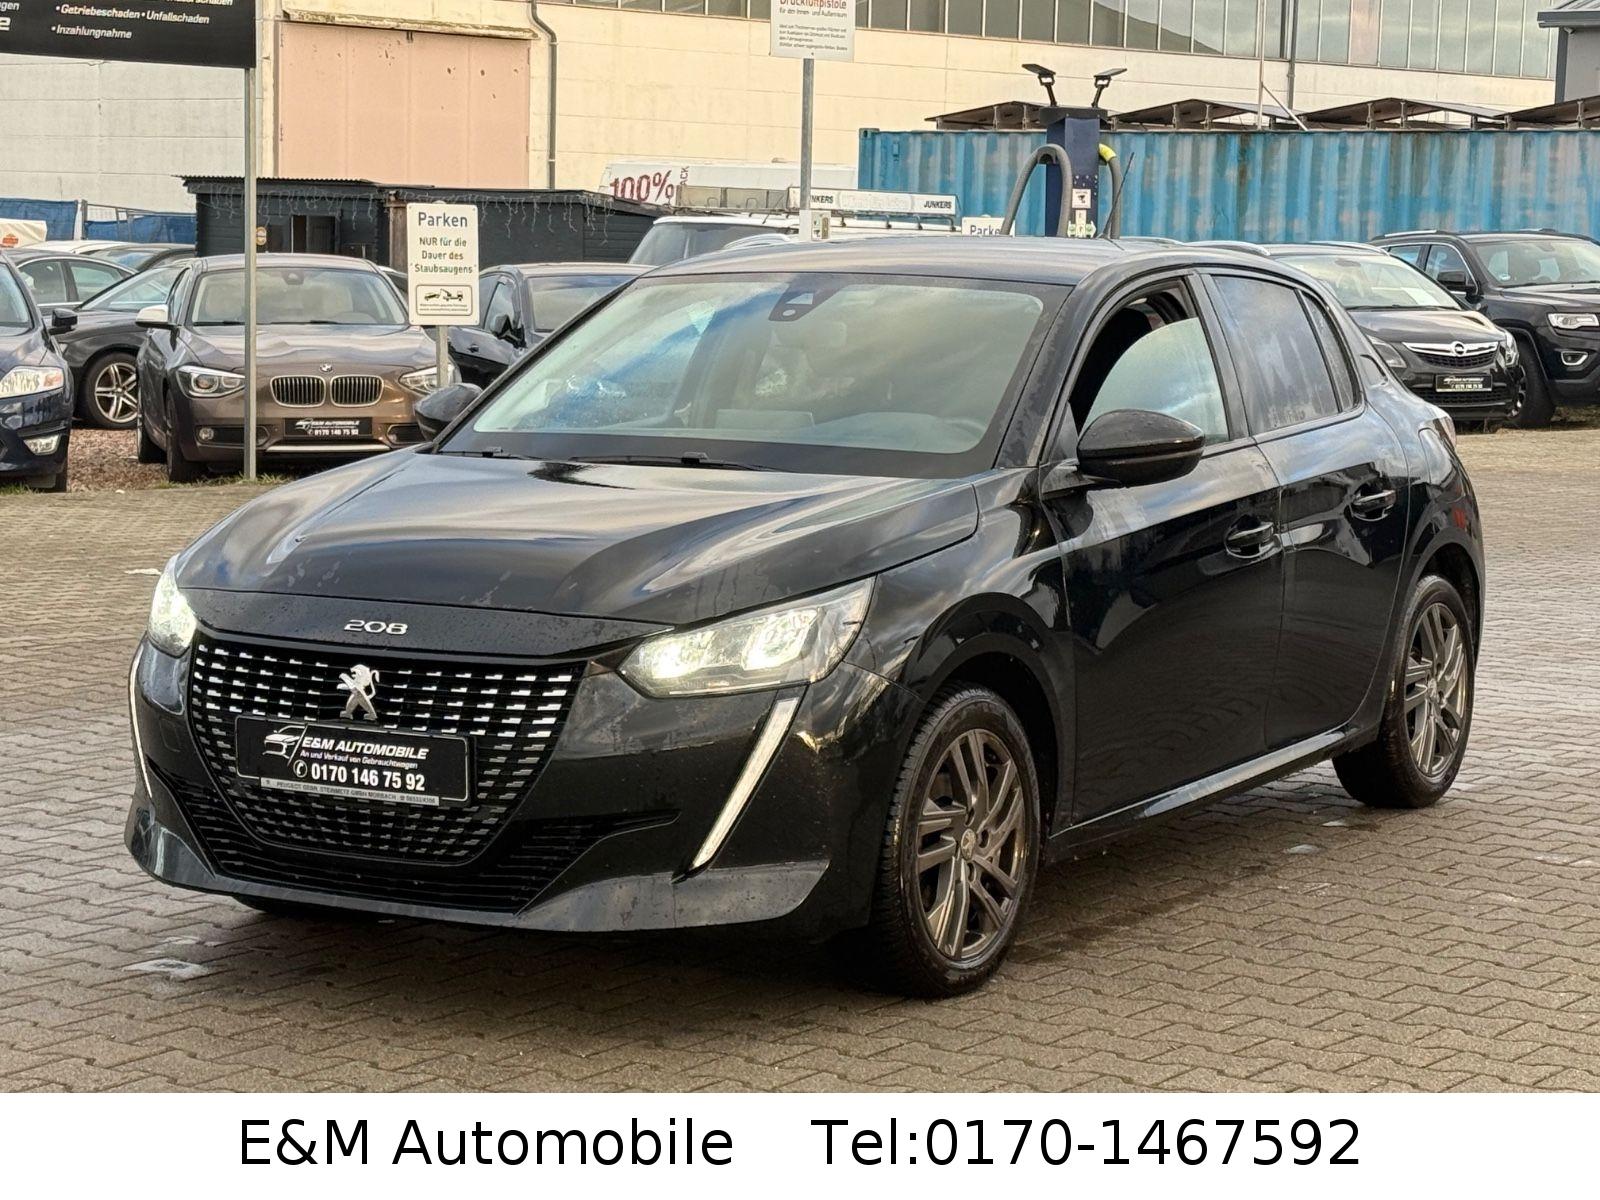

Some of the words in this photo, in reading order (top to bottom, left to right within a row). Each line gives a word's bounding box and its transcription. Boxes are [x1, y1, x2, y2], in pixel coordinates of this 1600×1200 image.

[60, 3, 140, 19] Getriebeschaden
[146, 10, 210, 24] Unfallschaden
[56, 24, 132, 39] Inzahlungnahme
[610, 169, 675, 202] 100%
[923, 200, 952, 209] JUNKERS
[418, 211, 468, 228] Parken
[970, 224, 1002, 236] Parke
[419, 237, 438, 246] NUR
[439, 237, 452, 247] für
[454, 238, 467, 247] die
[421, 250, 447, 260] Dauer
[448, 251, 464, 260] des
[414, 263, 473, 275] Staubsaugens
[343, 619, 408, 635] 208
[302, 736, 335, 751] E&M
[335, 740, 430, 760] AUTOMOBILE
[300, 749, 310, 758] An
[310, 751, 323, 759] und
[323, 752, 349, 762] Verkauf
[361, 756, 418, 770] Gebrauchtwagen
[311, 762, 348, 783] 0170
[351, 767, 379, 787] 146
[382, 771, 402, 789] 75
[405, 773, 425, 791] 92
